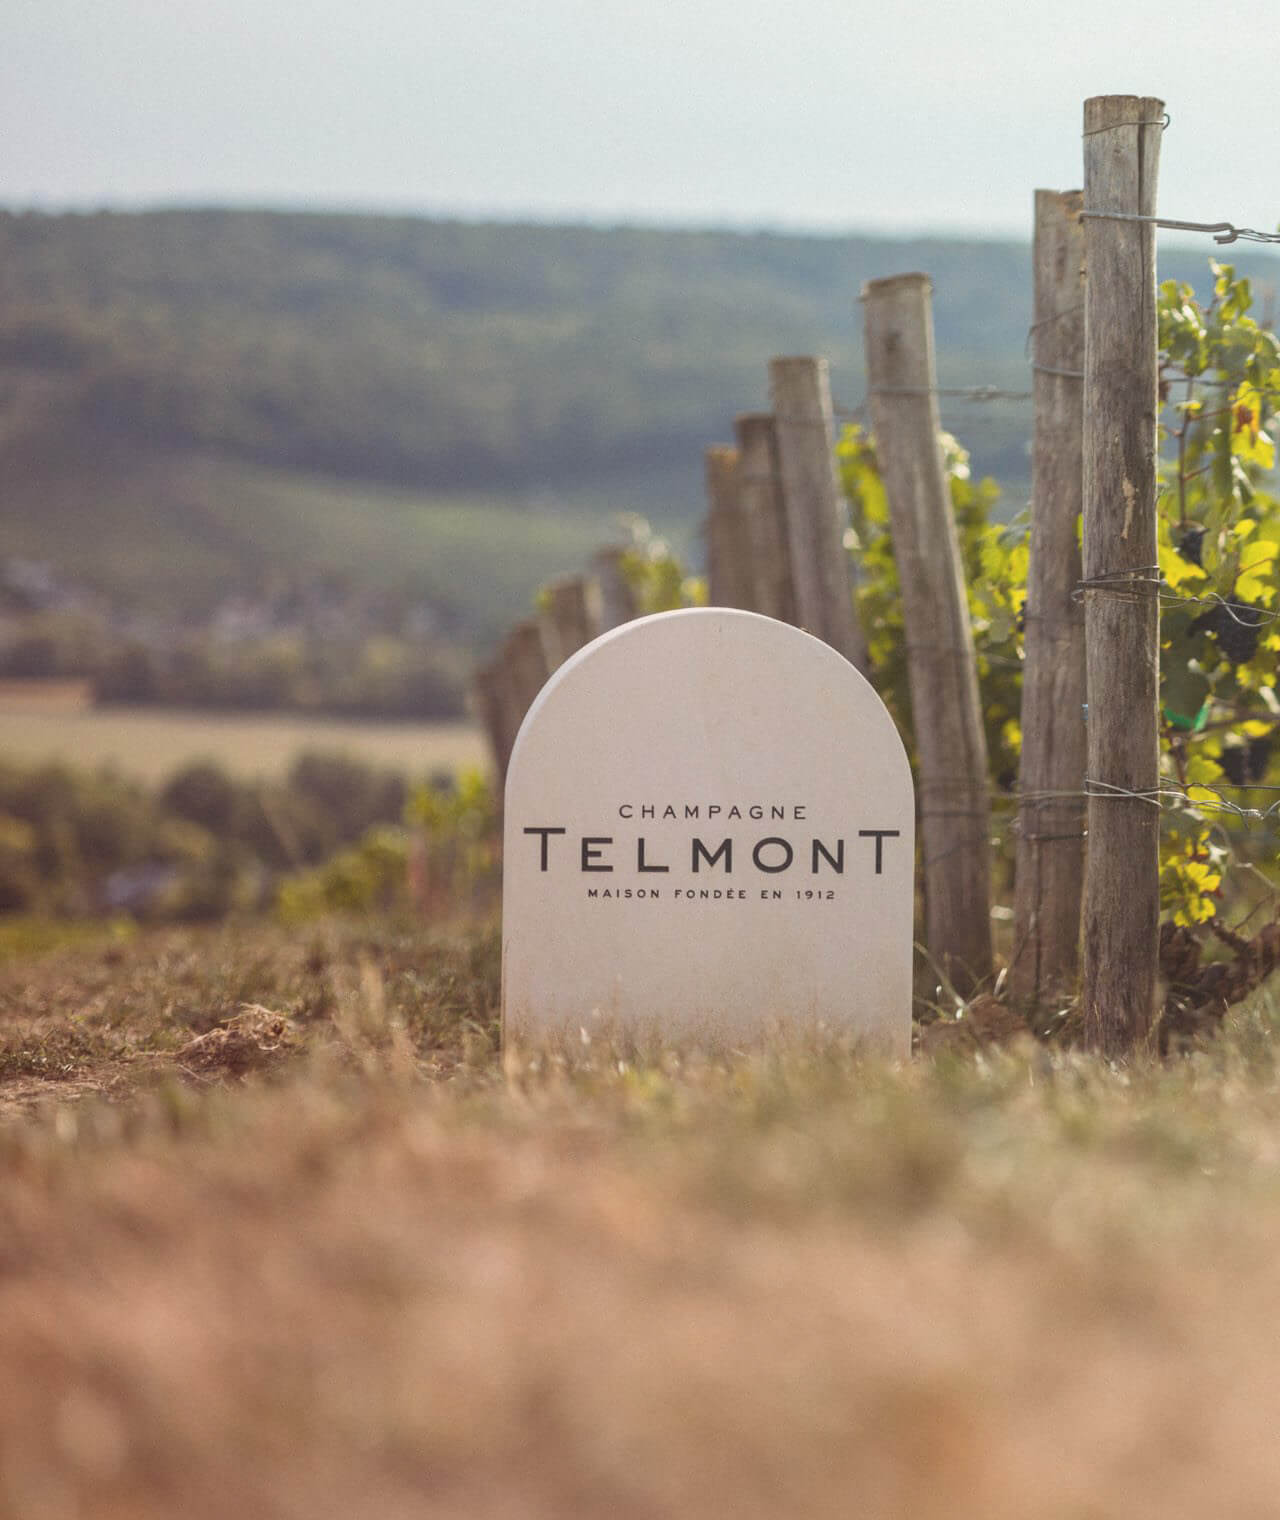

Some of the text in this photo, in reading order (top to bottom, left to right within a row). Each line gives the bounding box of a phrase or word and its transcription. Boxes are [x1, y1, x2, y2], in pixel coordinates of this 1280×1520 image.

[618, 804, 806, 820] CHAMPAGNE
[522, 826, 901, 875] TELMONT
[587, 887, 836, 900] MAISON FONDÉE EN 1912
